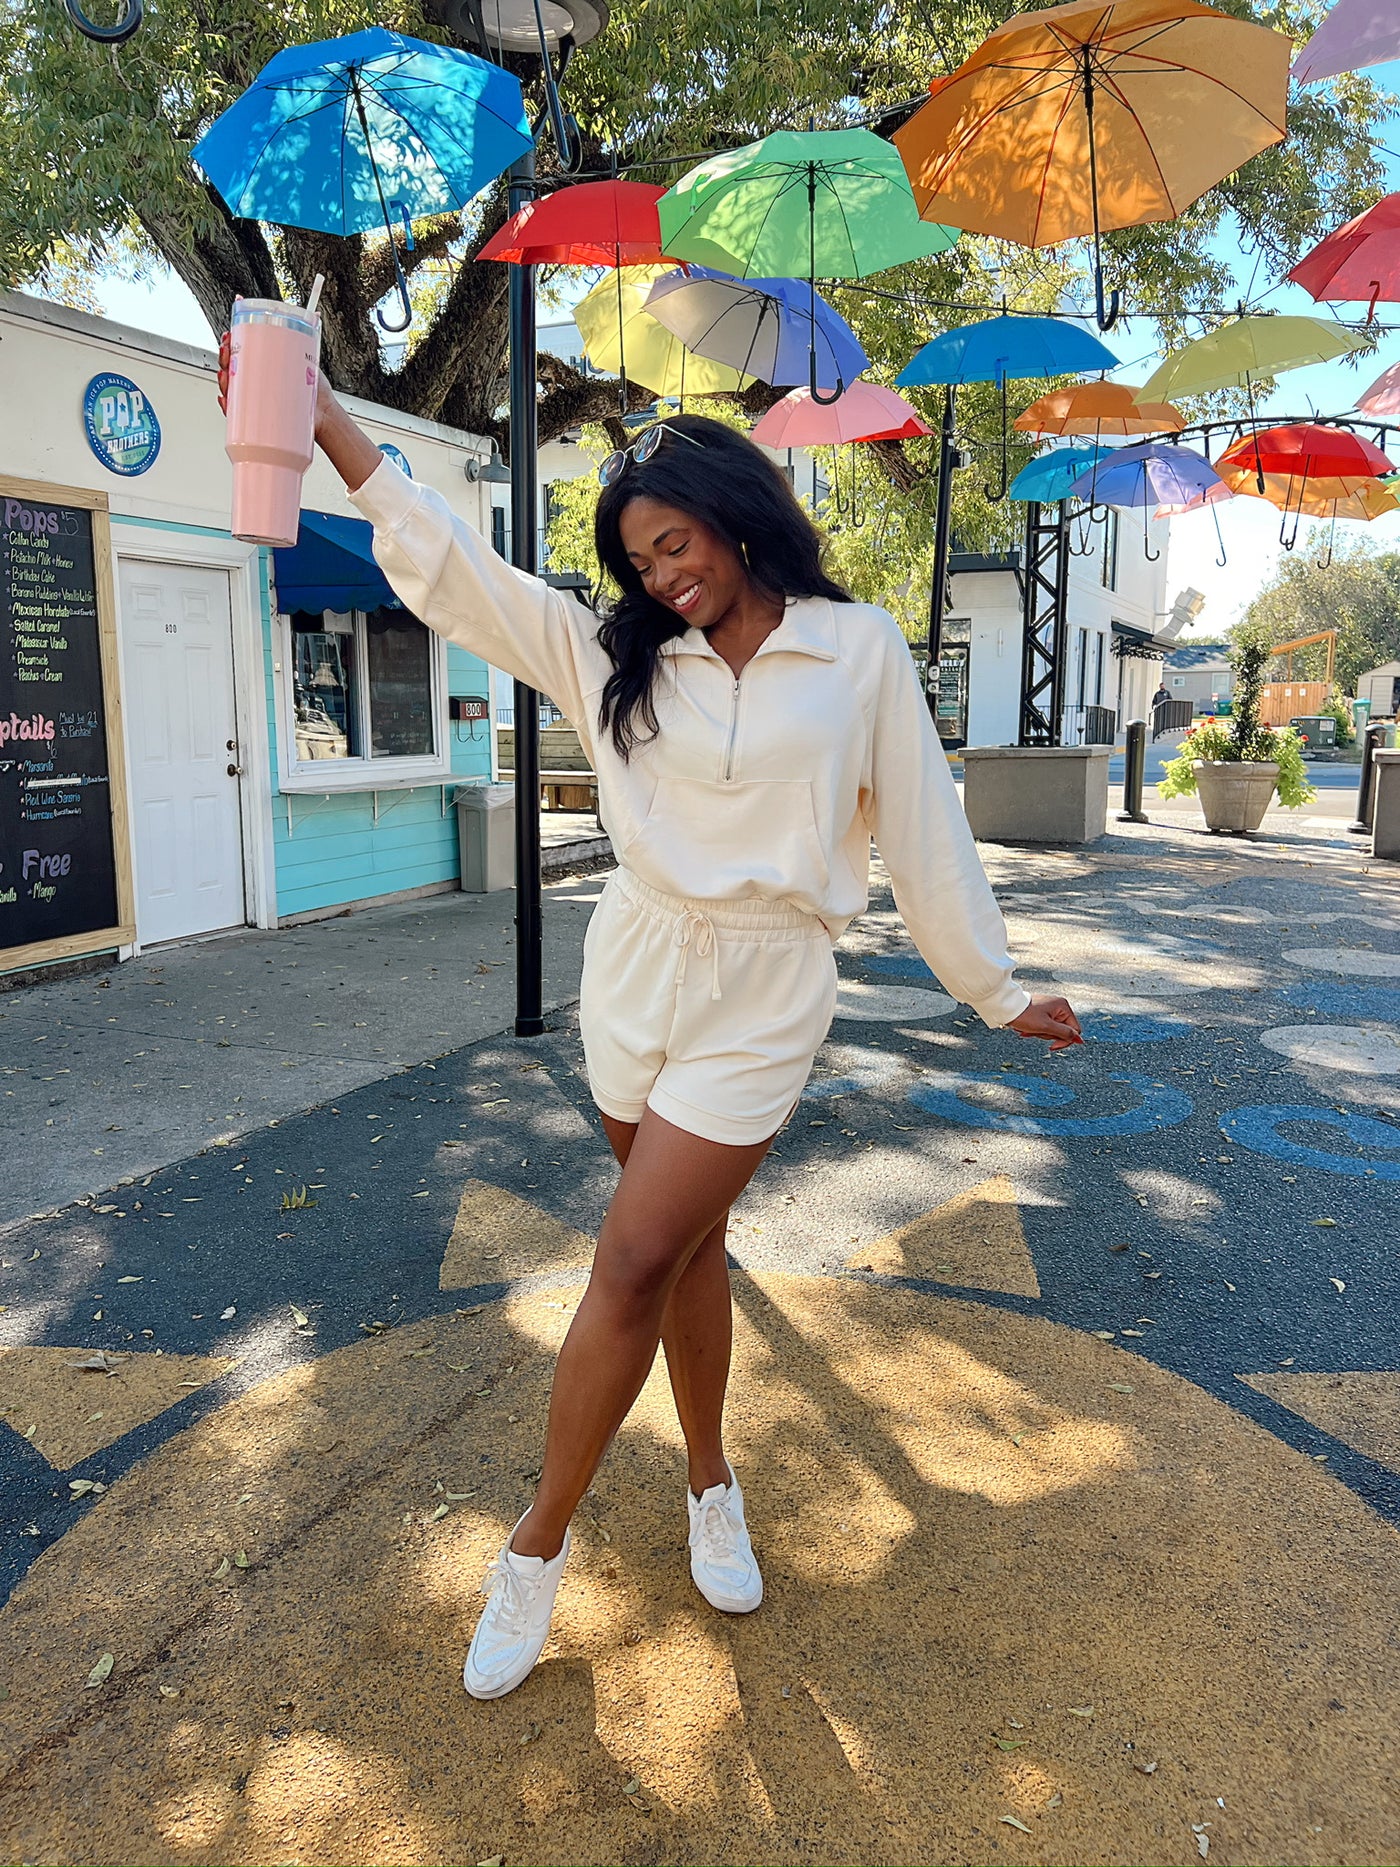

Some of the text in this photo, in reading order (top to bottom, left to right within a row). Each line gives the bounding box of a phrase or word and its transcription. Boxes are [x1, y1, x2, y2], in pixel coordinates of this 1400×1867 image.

[106, 431, 150, 454] BROTHERS
[4, 499, 79, 537] Pops $5
[9, 531, 49, 548] Cotton Candy
[10, 548, 74, 569] Pistachio Milk Honey
[12, 566, 56, 583] Birthday Cake
[11, 583, 34, 598] Banana
[12, 602, 42, 616] Mexican
[14, 619, 60, 633] Salted Caramel
[165, 623, 177, 633] 800
[50, 636, 68, 650] Vanilla
[44, 668, 63, 682] Cream
[466, 703, 482, 716] 800
[25, 793, 40, 805] Red
[22, 849, 71, 880] Free
[33, 882, 57, 903] Mango
